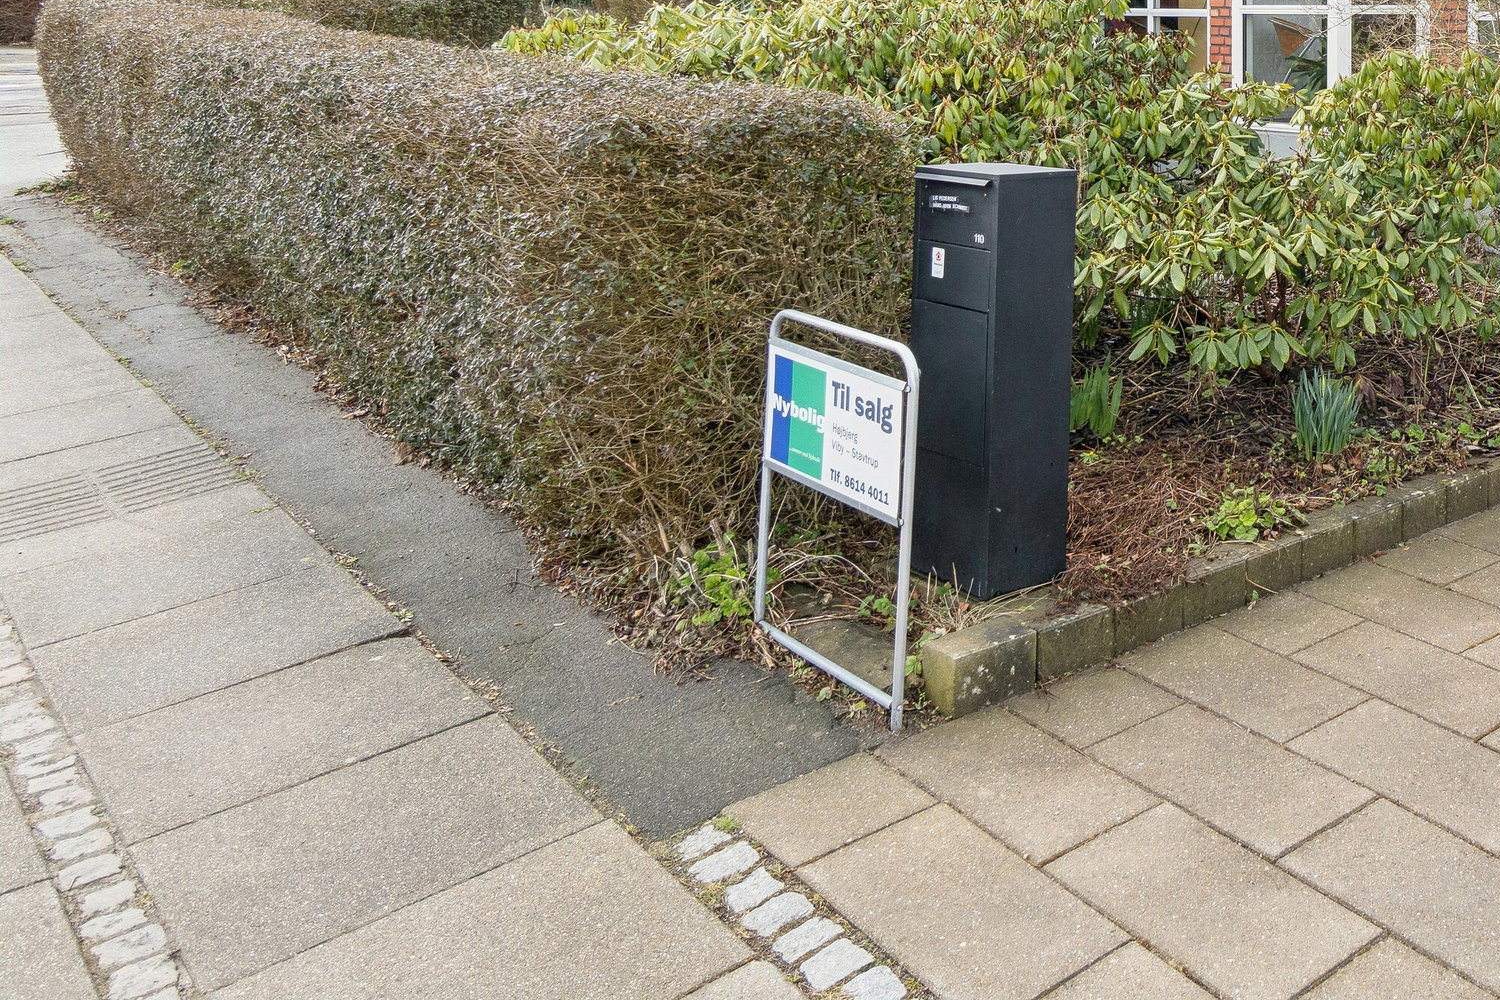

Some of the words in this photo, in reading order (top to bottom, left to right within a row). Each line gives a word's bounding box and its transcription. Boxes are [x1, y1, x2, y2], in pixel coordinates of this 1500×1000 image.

[974, 233, 985, 244] 110
[773, 392, 825, 434] Nybolig
[832, 380, 850, 412] Til
[855, 396, 894, 434] salg
[832, 422, 858, 444] Højbjerg
[831, 439, 844, 455] Viby
[851, 448, 879, 469] Stavtrup
[830, 468, 842, 485] Tlf.
[844, 475, 865, 494] 8614
[868, 485, 889, 506] 4011
